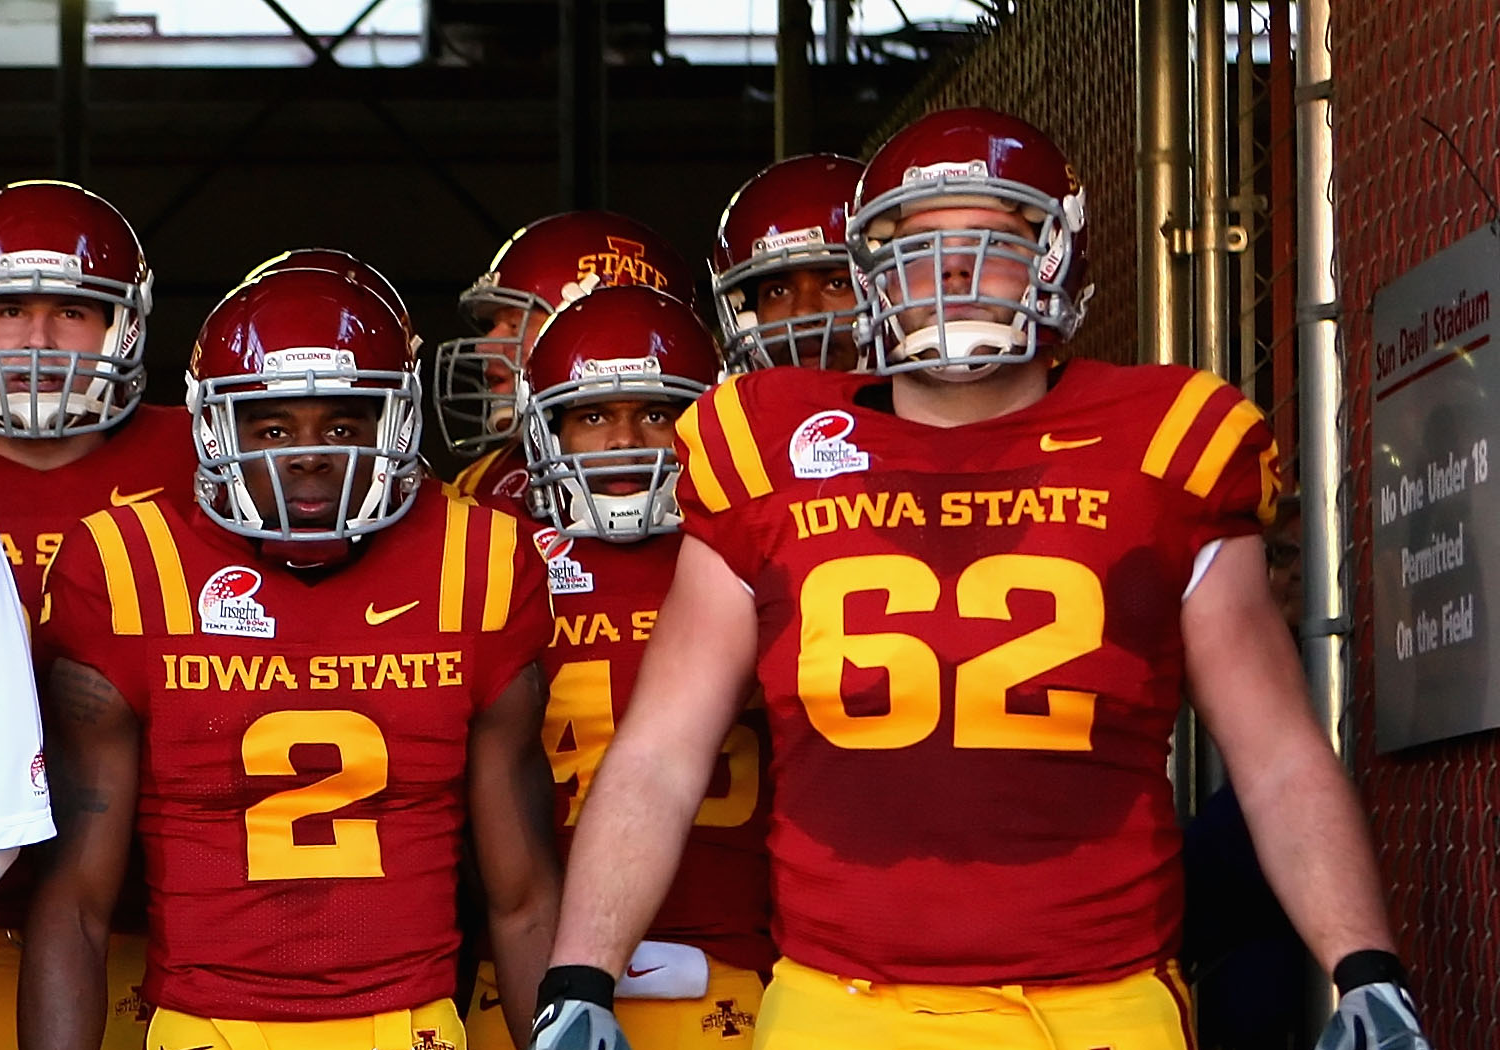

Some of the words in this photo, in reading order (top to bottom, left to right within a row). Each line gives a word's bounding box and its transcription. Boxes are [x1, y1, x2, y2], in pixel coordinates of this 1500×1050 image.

[15, 256, 60, 265] CYCLONES
[285, 352, 331, 361] CYCLONES
[1376, 343, 1396, 380] Sun
[1400, 311, 1428, 366] Devil
[1433, 289, 1489, 346] Stadium
[789, 491, 925, 539] IOWA
[940, 486, 1110, 530] STATE
[1381, 484, 1397, 526] No
[1400, 474, 1424, 517] One
[1428, 451, 1467, 504] Under
[1471, 438, 1488, 484] 18
[1401, 521, 1463, 588] Permitted
[220, 600, 258, 625] Insight
[1396, 619, 1413, 661] On
[1416, 610, 1437, 653] the
[1442, 593, 1474, 646] Field
[162, 654, 298, 691] IOWA
[310, 650, 463, 690] STATE
[798, 554, 1105, 752] 62
[241, 710, 388, 881] 2
